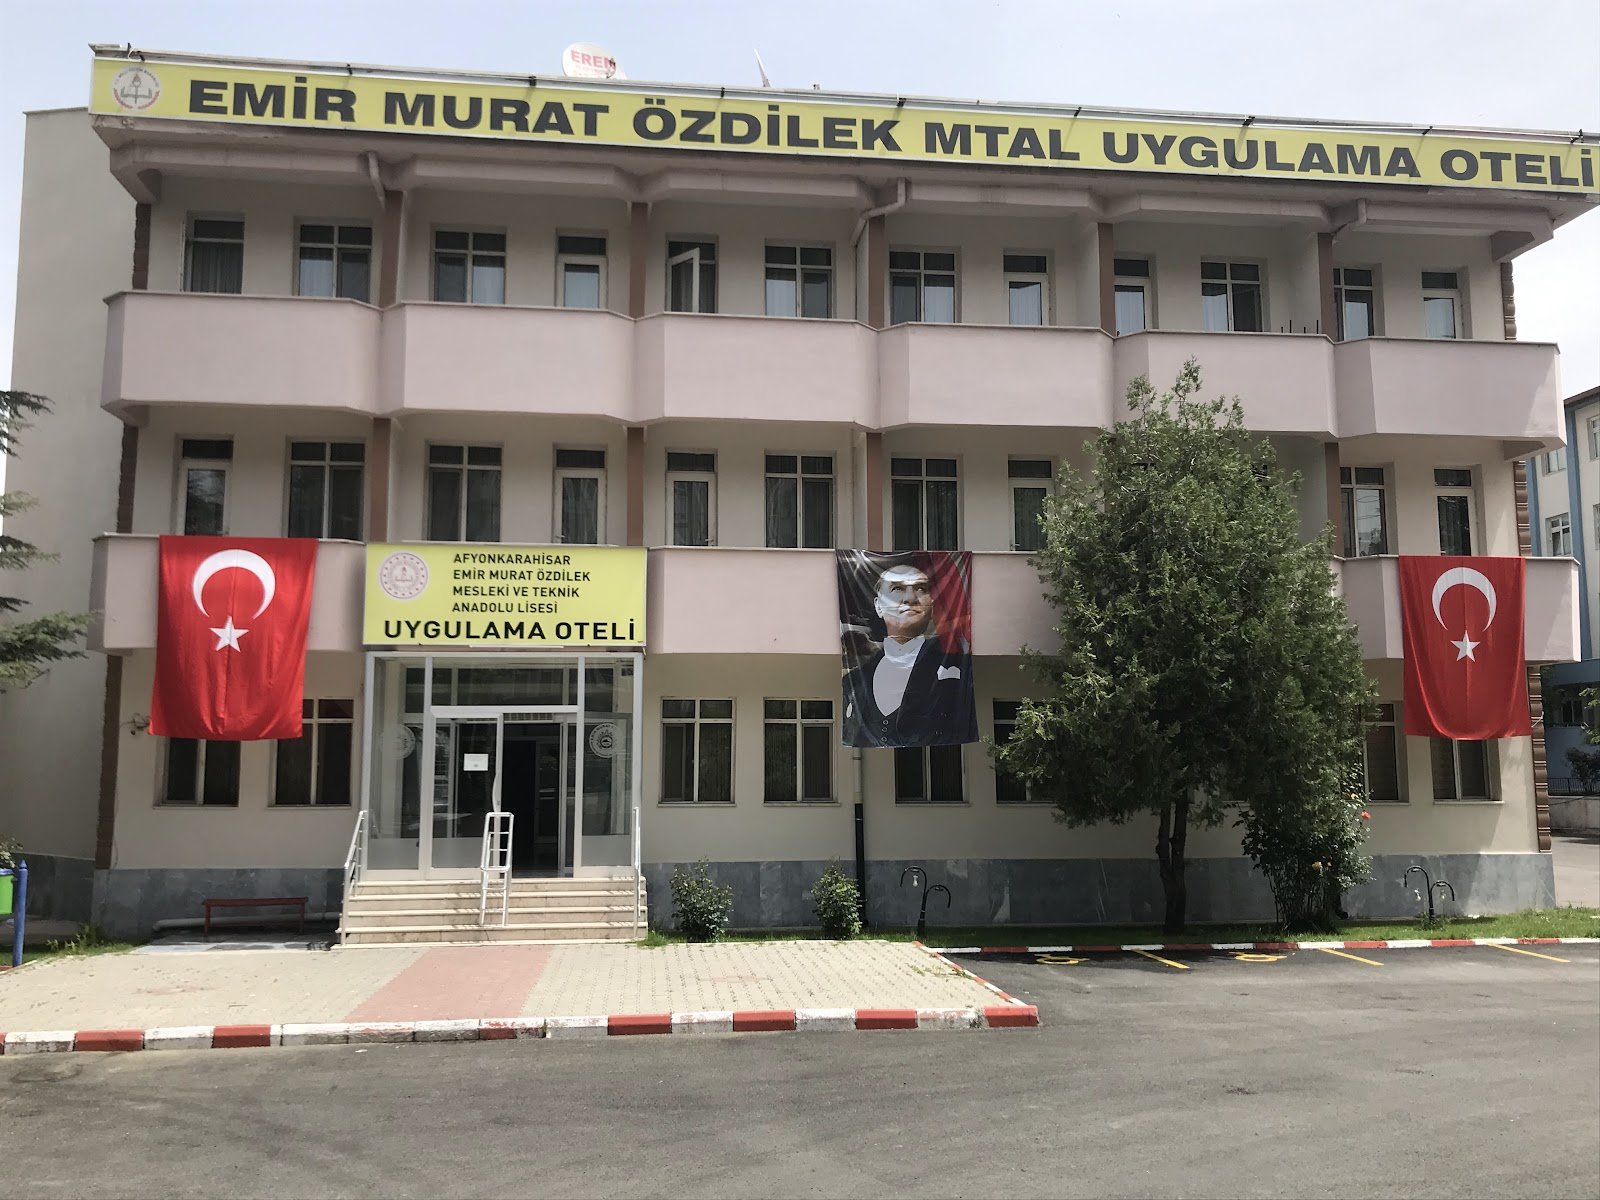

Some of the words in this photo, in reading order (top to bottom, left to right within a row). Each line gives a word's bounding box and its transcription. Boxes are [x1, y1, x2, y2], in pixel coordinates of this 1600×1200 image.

[189, 76, 356, 122] EMİR
[384, 91, 609, 137] MURAT
[632, 97, 903, 152] ÖZDİLEK
[924, 122, 1080, 161] MTAL
[1102, 131, 1422, 178] UYGULAMA
[1440, 148, 1595, 187] OTELİ
[453, 552, 571, 565] AFYONKARAHİSAR
[453, 567, 486, 580] EMİR
[489, 569, 533, 580] MURAT
[536, 568, 591, 582] ÖZDİLEK
[453, 583, 509, 597] MESLEKİ
[513, 586, 529, 597] VE
[532, 585, 580, 598] TEKNİK
[452, 602, 514, 613] ANADOLU
[517, 601, 558, 614] LİSESİ
[384, 620, 546, 640] UYGULAMA
[555, 618, 635, 641] OTELİ
